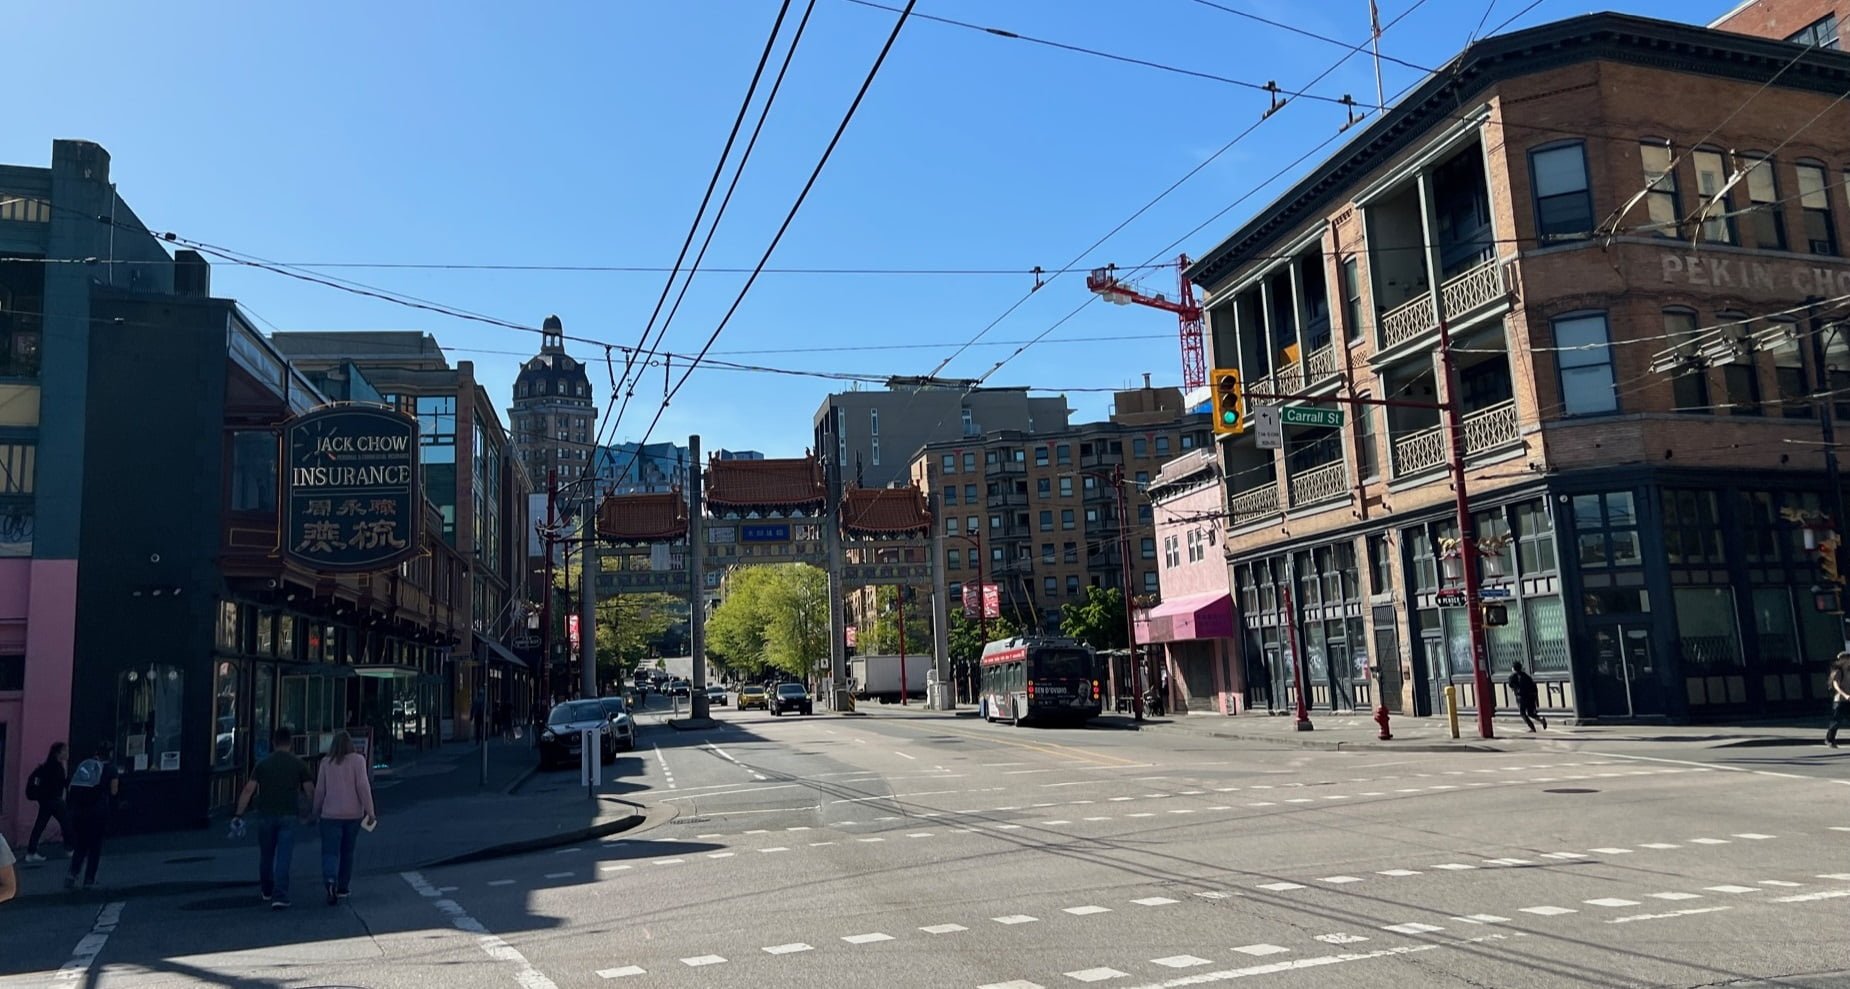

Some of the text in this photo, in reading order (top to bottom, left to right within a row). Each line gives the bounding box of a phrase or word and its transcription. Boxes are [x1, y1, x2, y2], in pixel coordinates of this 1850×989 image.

[1661, 253, 1774, 292] PEKIN
[1287, 409, 1340, 424] Carrall St
[314, 435, 408, 456] JACK CHOW
[292, 465, 411, 487] INSURANCE
